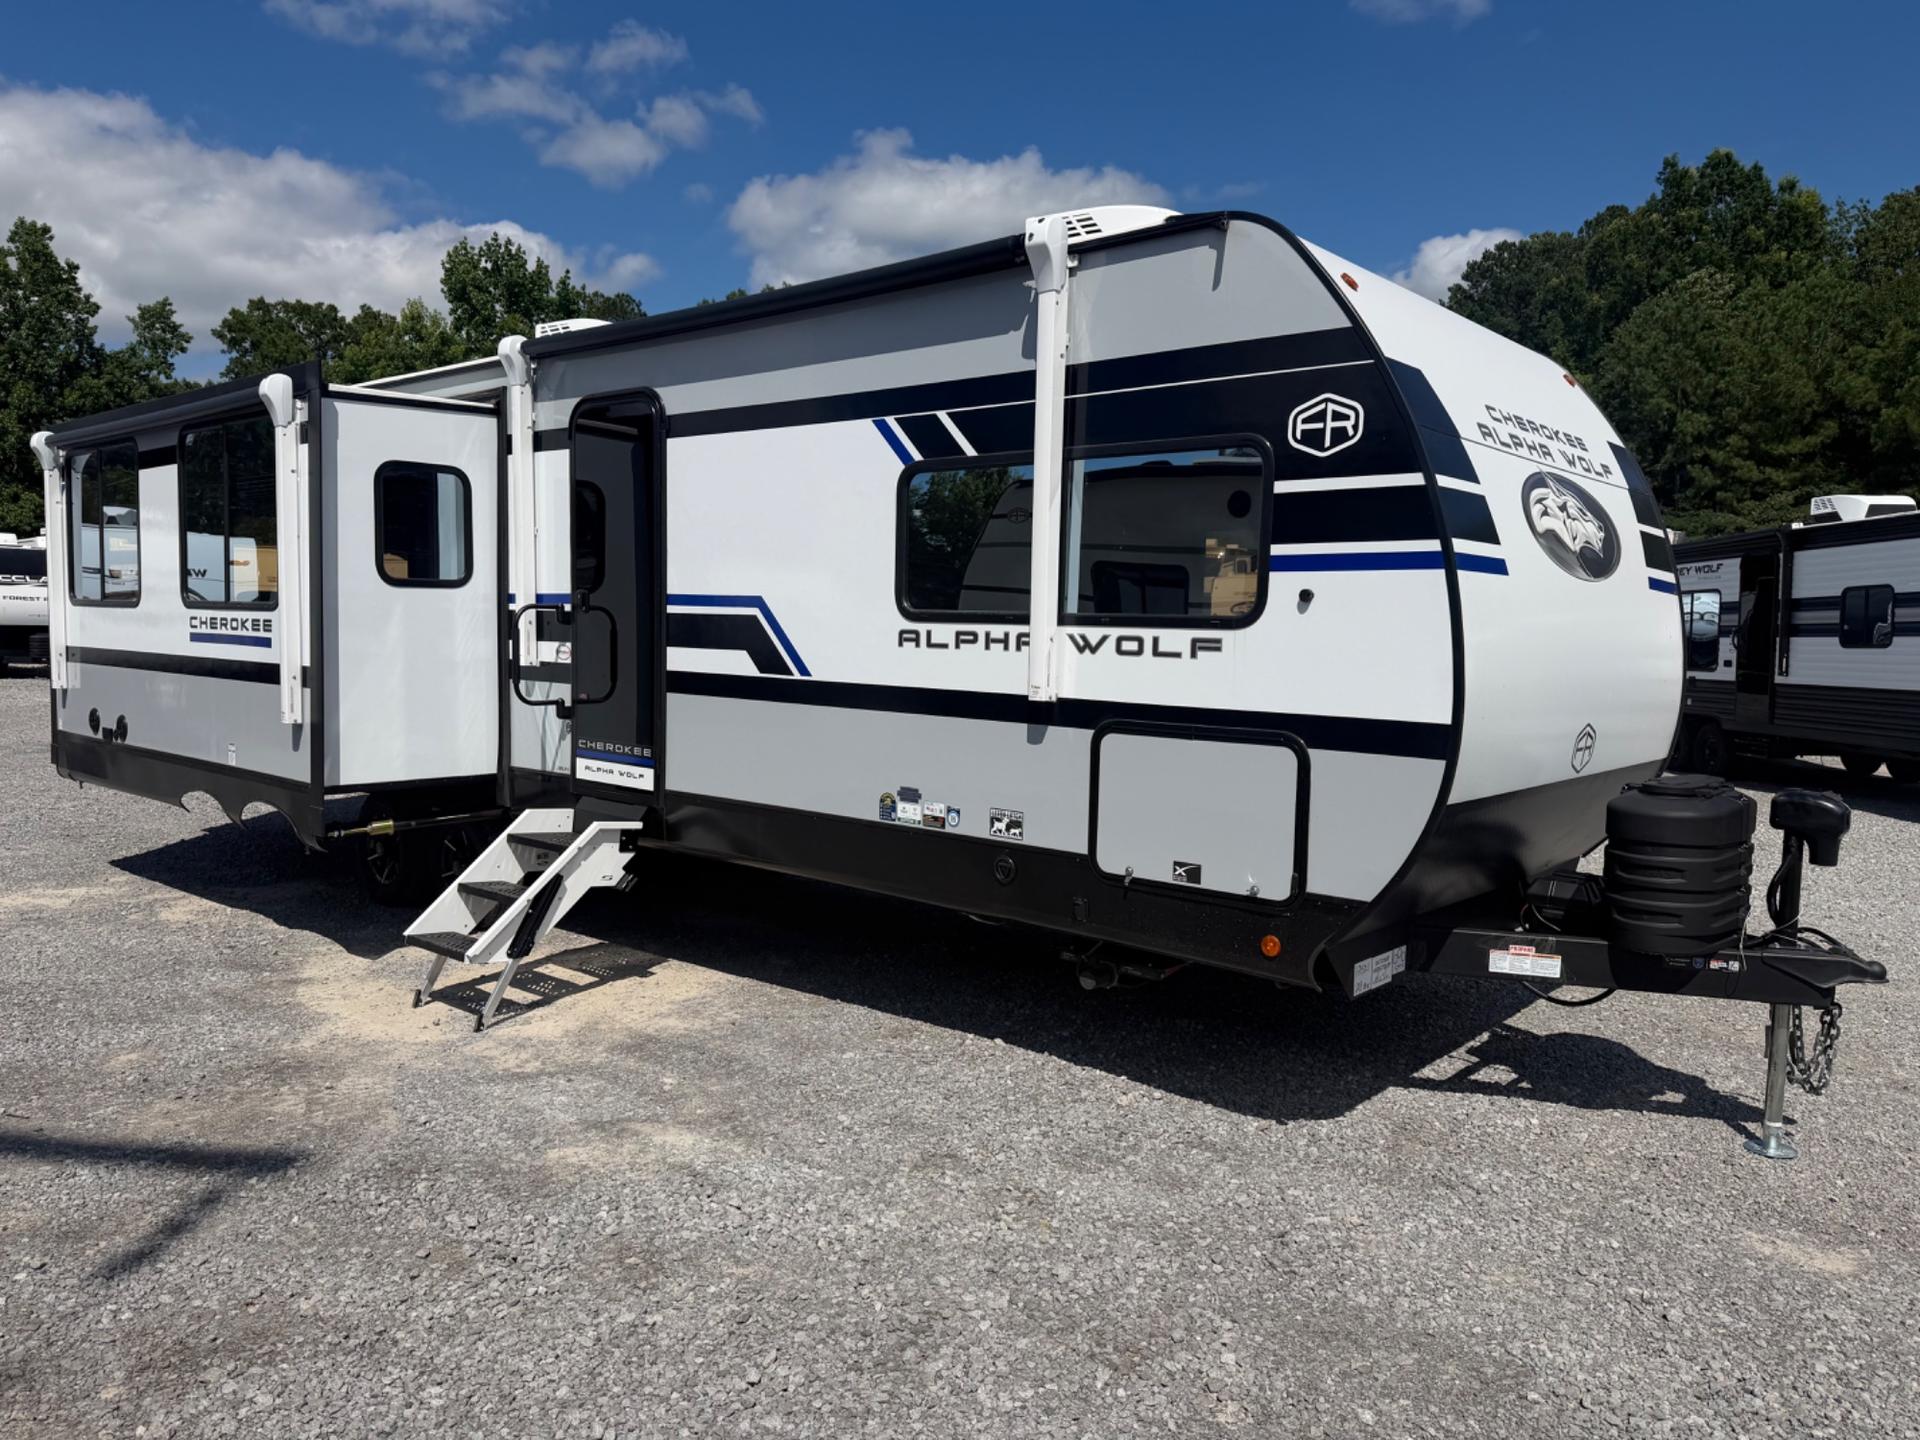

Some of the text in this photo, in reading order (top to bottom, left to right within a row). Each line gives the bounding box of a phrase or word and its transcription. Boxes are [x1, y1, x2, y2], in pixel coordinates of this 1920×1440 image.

[1485, 404, 1590, 452] CHEROKEE
[1476, 422, 1614, 479] ALPHA WOLF
[1677, 563, 1723, 576] EY WOLF
[189, 616, 272, 633] CHEROKEE
[898, 629, 1223, 659] ALPHA WOLF
[578, 739, 652, 757] CHEROKEE
[584, 765, 645, 779] ALPHA WOLF
